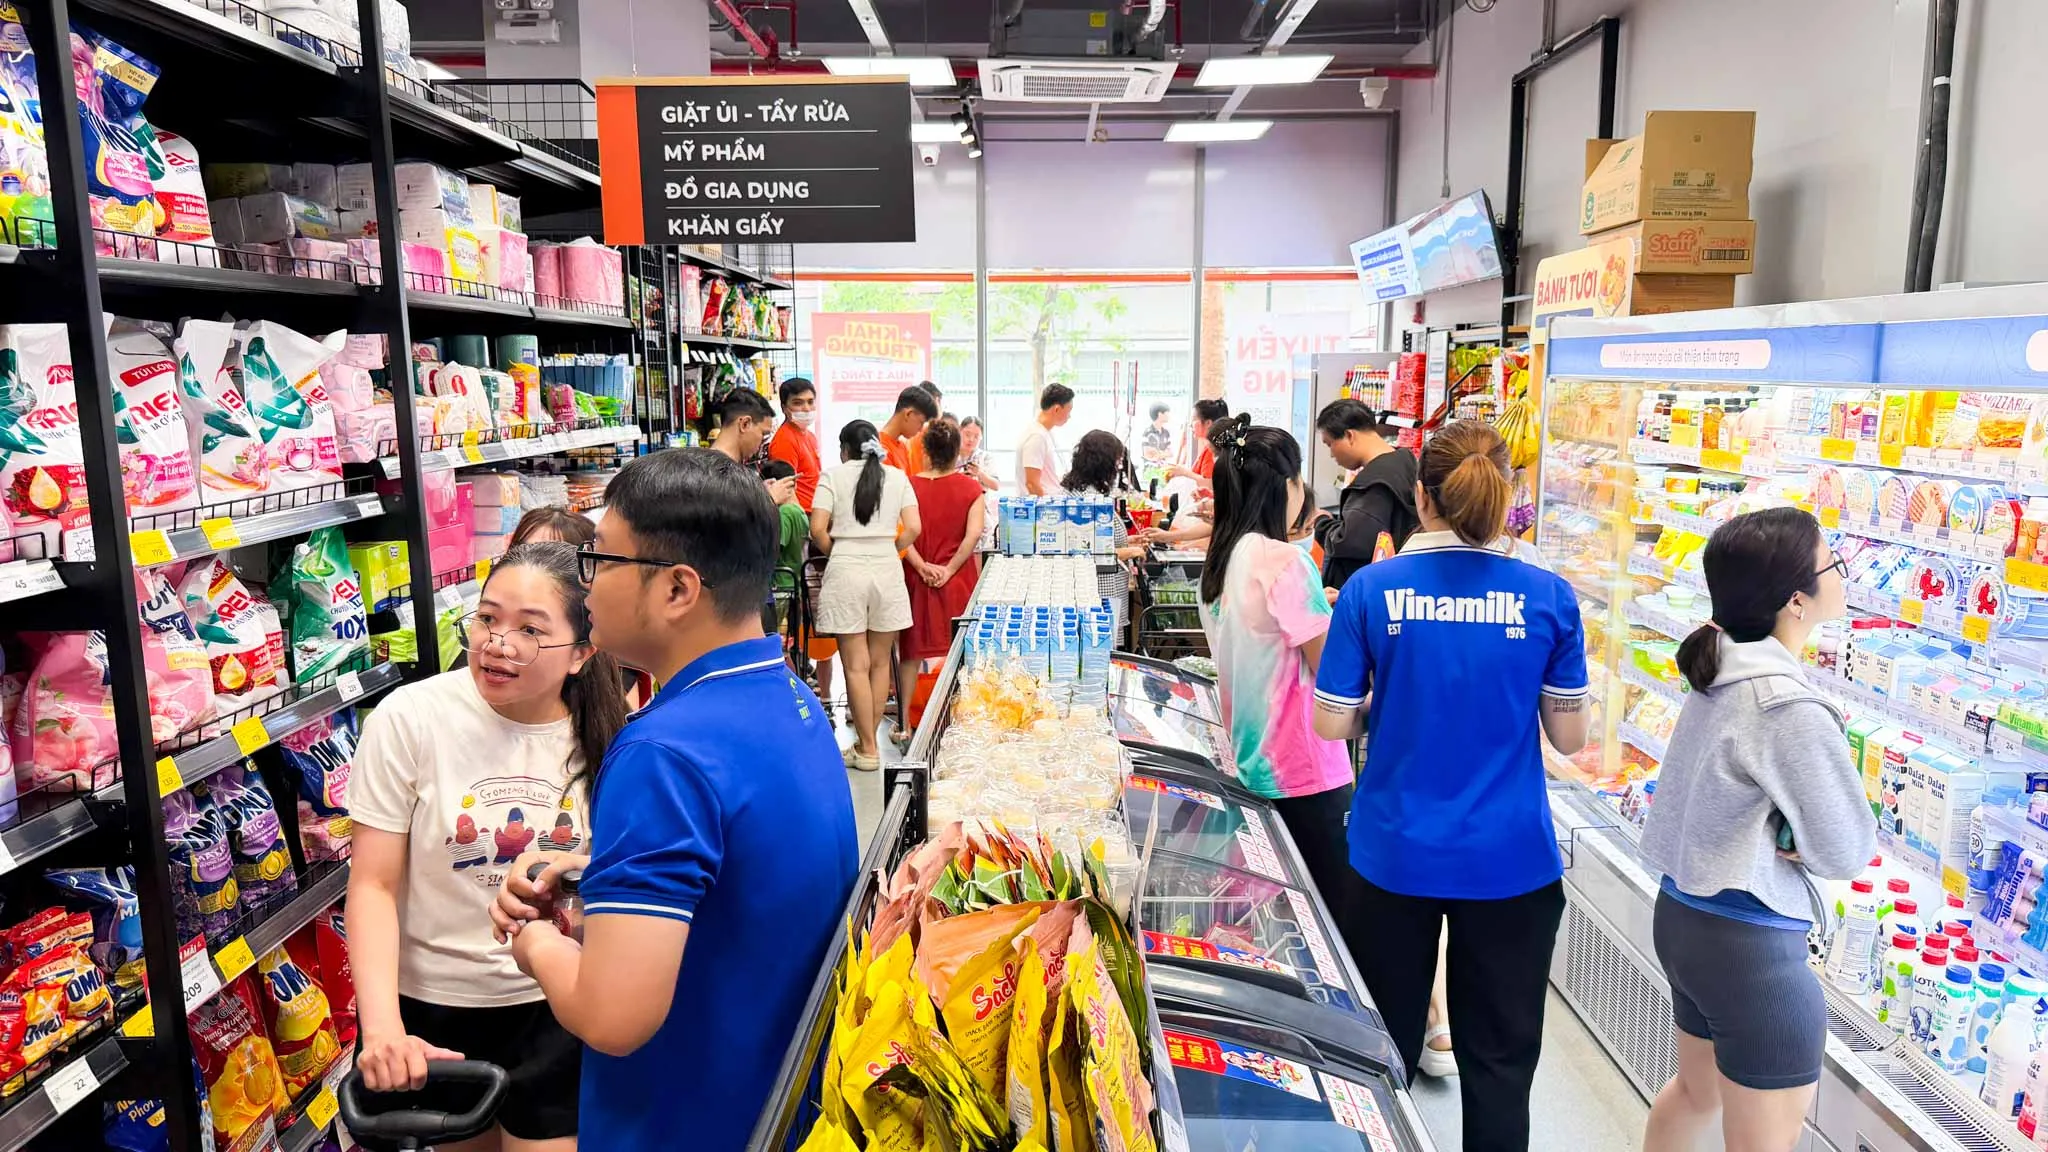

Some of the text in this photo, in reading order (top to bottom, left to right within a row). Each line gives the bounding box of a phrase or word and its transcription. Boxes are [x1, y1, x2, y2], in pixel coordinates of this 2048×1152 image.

[661, 101, 711, 127] GIẶT
[716, 101, 738, 123] ỦI
[759, 98, 798, 122] TẨY
[804, 99, 850, 122] RỬA
[664, 137, 765, 162] MỸ PHẨM
[665, 176, 809, 203] ĐỒ GIA DỤNG
[668, 212, 784, 236] KHĂN GIẤY
[1649, 228, 1698, 253] Staff
[1537, 268, 1597, 306] BÁNH TƯƠI
[1718, 349, 1739, 366] trạng
[1384, 588, 1525, 625] Vinamilk
[332, 614, 366, 640] 10X
[1388, 623, 1526, 639] EST 1976
[2010, 711, 2043, 736] Vinamilk
[2006, 742, 2013, 751] 24
[1908, 767, 1925, 781] Dalat
[1928, 776, 1945, 791] Dalat
[220, 786, 272, 831] OMO
[2000, 870, 2025, 921] Vinamilk
[184, 982, 203, 1003] 209
[970, 961, 1017, 1022] Sach
[74, 1078, 86, 1091] 22
